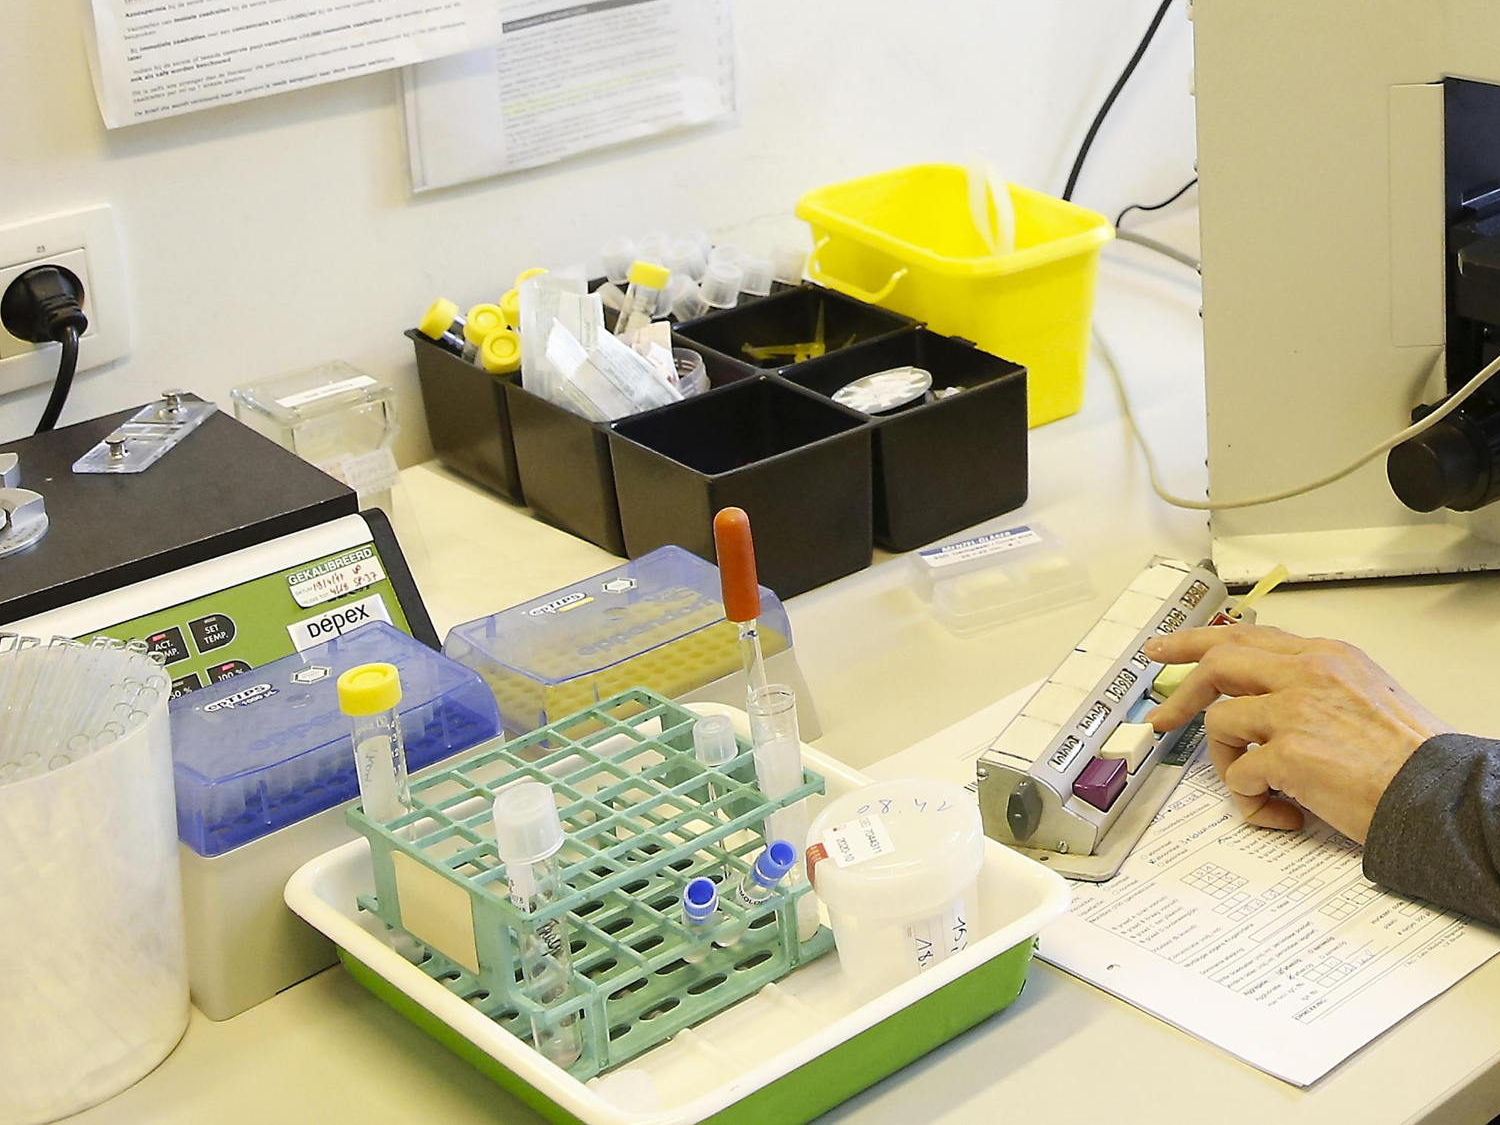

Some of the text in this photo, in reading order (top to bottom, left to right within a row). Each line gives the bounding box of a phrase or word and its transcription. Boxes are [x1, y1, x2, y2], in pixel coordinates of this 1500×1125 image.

[288, 548, 372, 584] GEKALIBREERD
[204, 624, 219, 634] SET
[204, 631, 229, 644] TEMP.
[155, 640, 174, 651] ACT.
